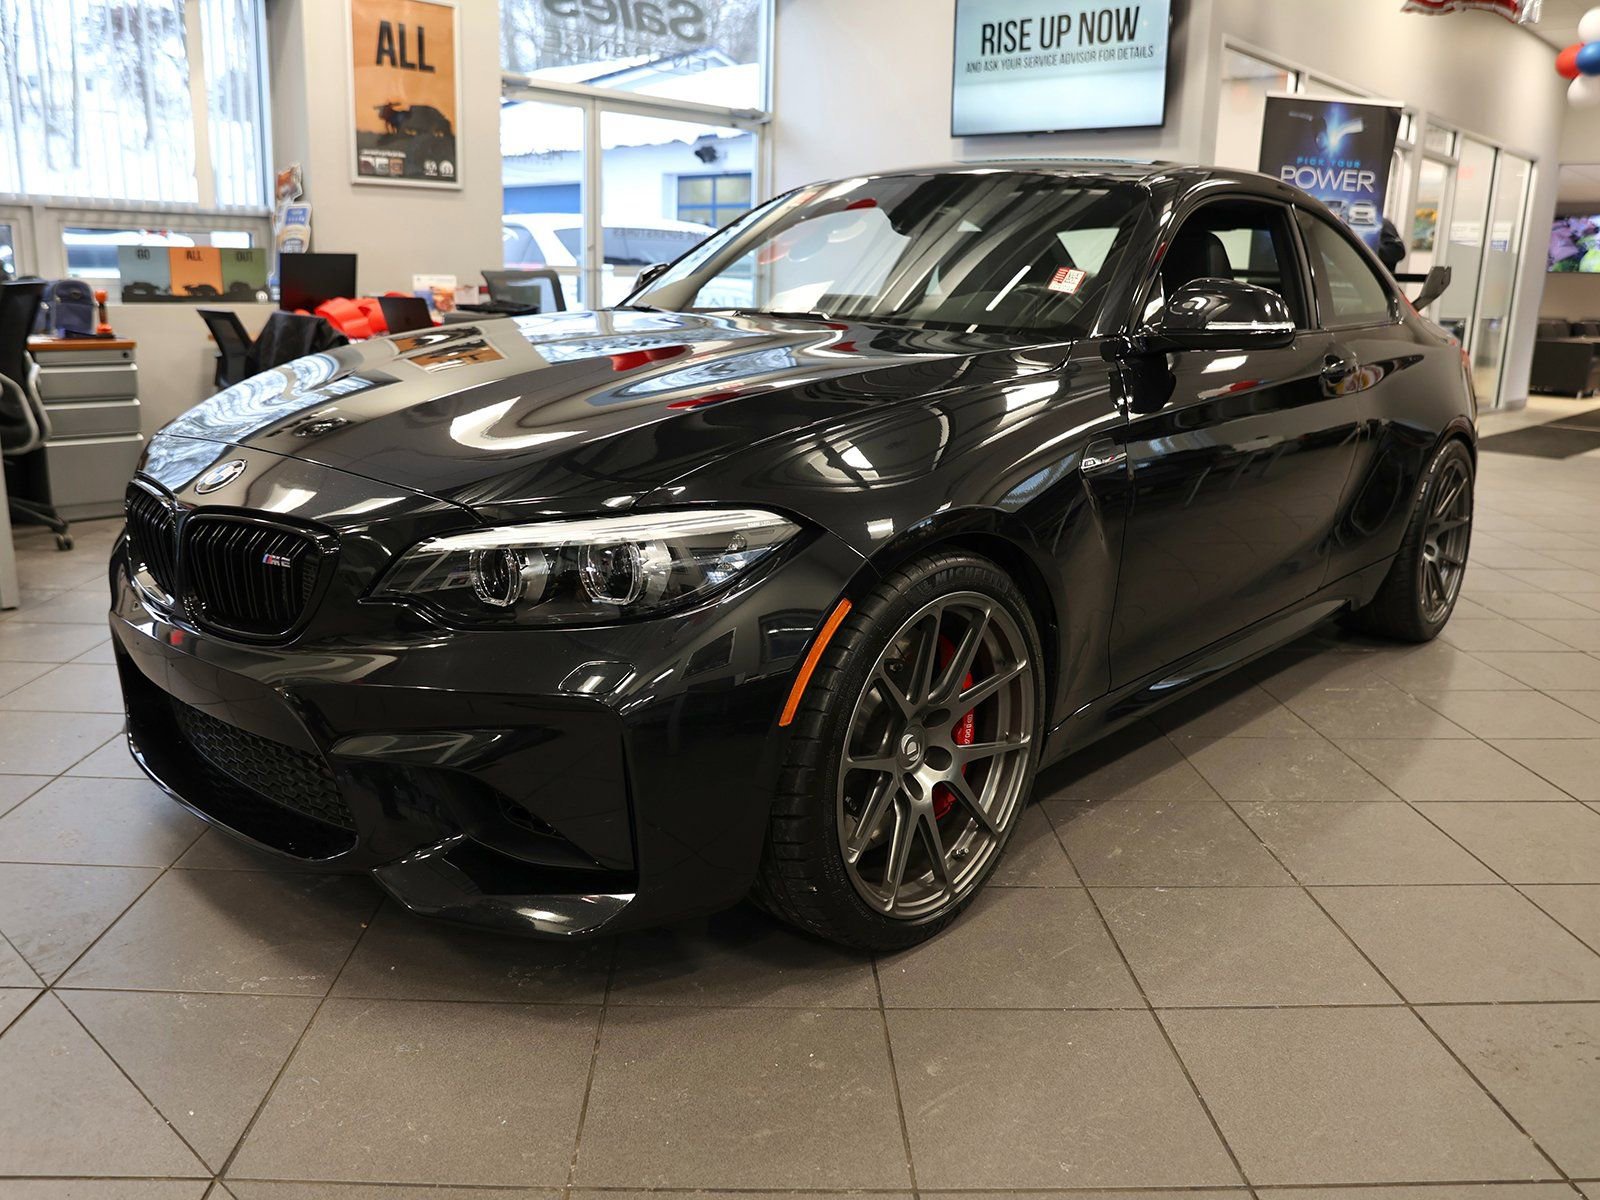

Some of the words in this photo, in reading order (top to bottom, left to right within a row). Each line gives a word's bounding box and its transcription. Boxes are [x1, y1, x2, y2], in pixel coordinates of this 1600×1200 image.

[981, 18, 1032, 56] RISE
[1040, 14, 1071, 49] UP
[1078, 6, 1140, 45] NOW
[376, 20, 435, 73] ALL
[965, 61, 983, 74] AND
[983, 58, 999, 72] ASK
[1001, 56, 1022, 70] YOUR
[1023, 54, 1057, 69] SERVICE
[1059, 50, 1098, 66] ADVISOR
[1098, 48, 1115, 62] FOR
[1117, 45, 1154, 60] DETAILS
[1280, 165, 1376, 193] POWER
[187, 250, 203, 261] ALL
